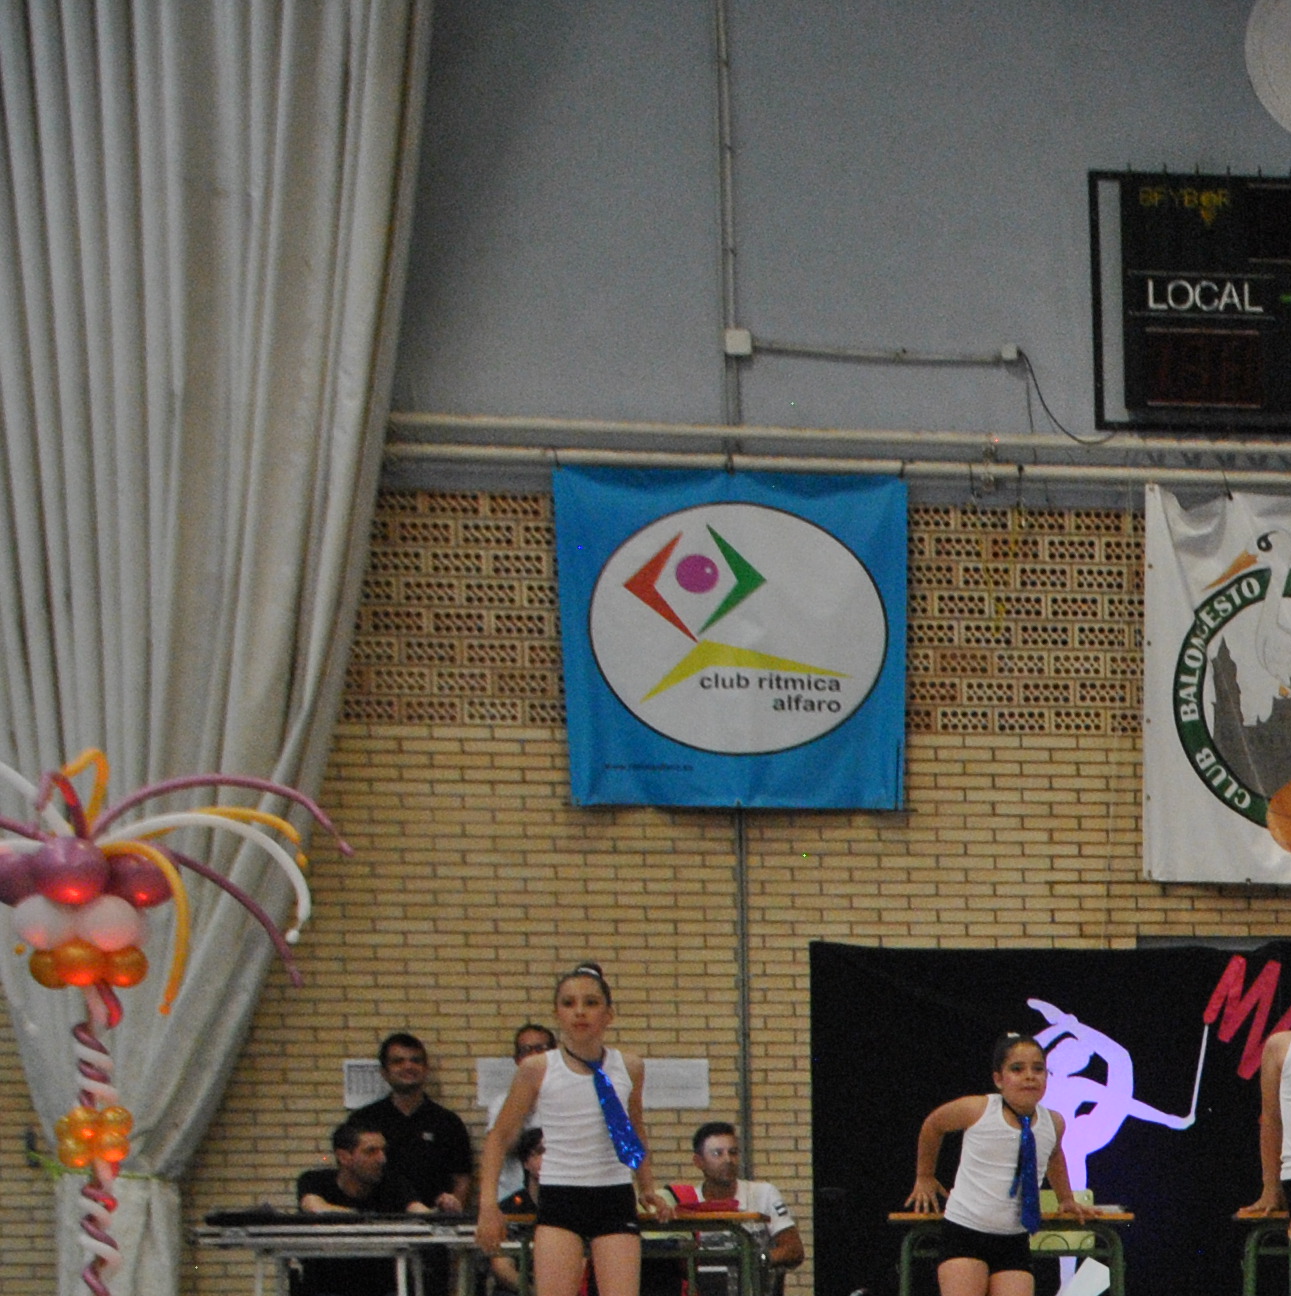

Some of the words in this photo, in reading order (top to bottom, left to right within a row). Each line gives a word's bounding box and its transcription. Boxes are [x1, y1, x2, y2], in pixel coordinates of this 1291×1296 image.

[1147, 279, 1263, 313] LOCAL
[699, 672, 750, 691] club
[757, 672, 842, 692] ritmica
[772, 694, 842, 714] alfaro
[1195, 746, 1252, 810] CLUB
